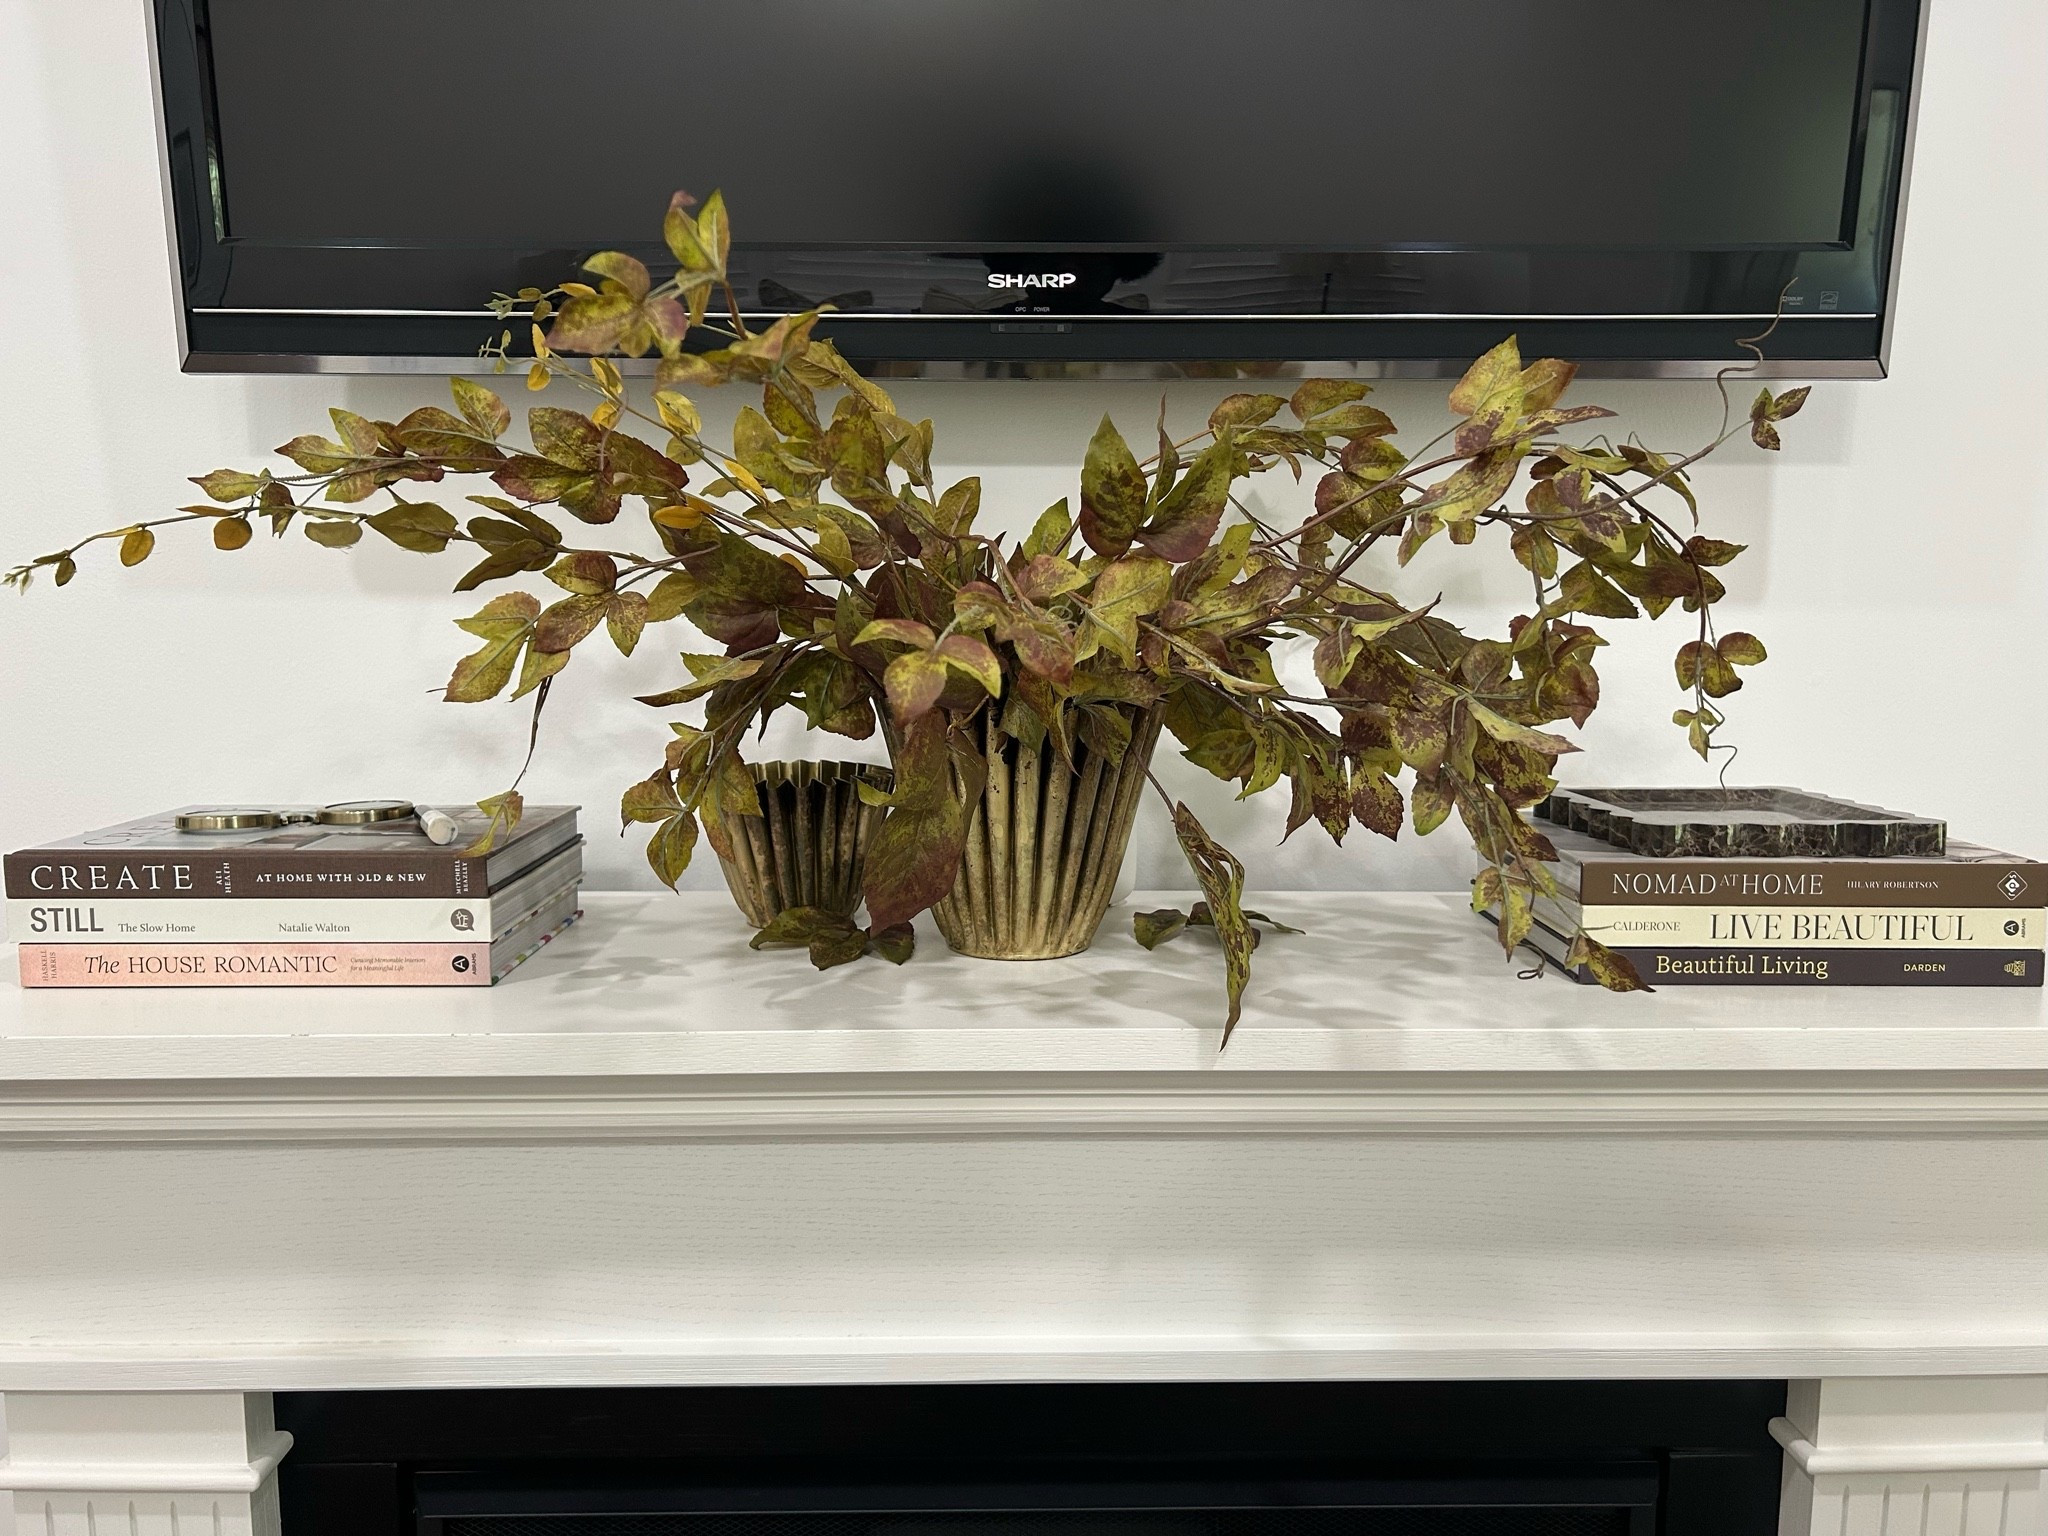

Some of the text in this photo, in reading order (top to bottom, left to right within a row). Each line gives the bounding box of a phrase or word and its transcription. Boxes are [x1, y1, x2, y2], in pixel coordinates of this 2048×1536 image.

[987, 272, 1077, 289] SHARP
[30, 864, 194, 891] CREATE
[215, 870, 223, 886] ALI
[223, 862, 232, 894] HEATH
[256, 873, 427, 883] AT HOME WITH OLD & NEW
[454, 859, 462, 895] MITCHELL
[1612, 873, 1824, 895] NOMAD AT HOME
[1847, 880, 1939, 890] HILARY ROBERTSON
[30, 907, 104, 933] STILL
[118, 923, 196, 933] The Slow Home
[278, 922, 350, 933] Natalie Walton
[1613, 921, 1681, 932] CALDERONE
[1709, 913, 1974, 941] LIVE BEAUTIFUL
[41, 949, 49, 982] HASKELL
[50, 951, 58, 979] HARRIS
[84, 955, 338, 974] The HOUSE ROMANTIC
[350, 965, 358, 973] for
[363, 965, 394, 973] Meaningful
[394, 965, 405, 973] Life
[1655, 954, 1829, 980] Beautiful Living
[1903, 963, 1946, 972] DARDEN
